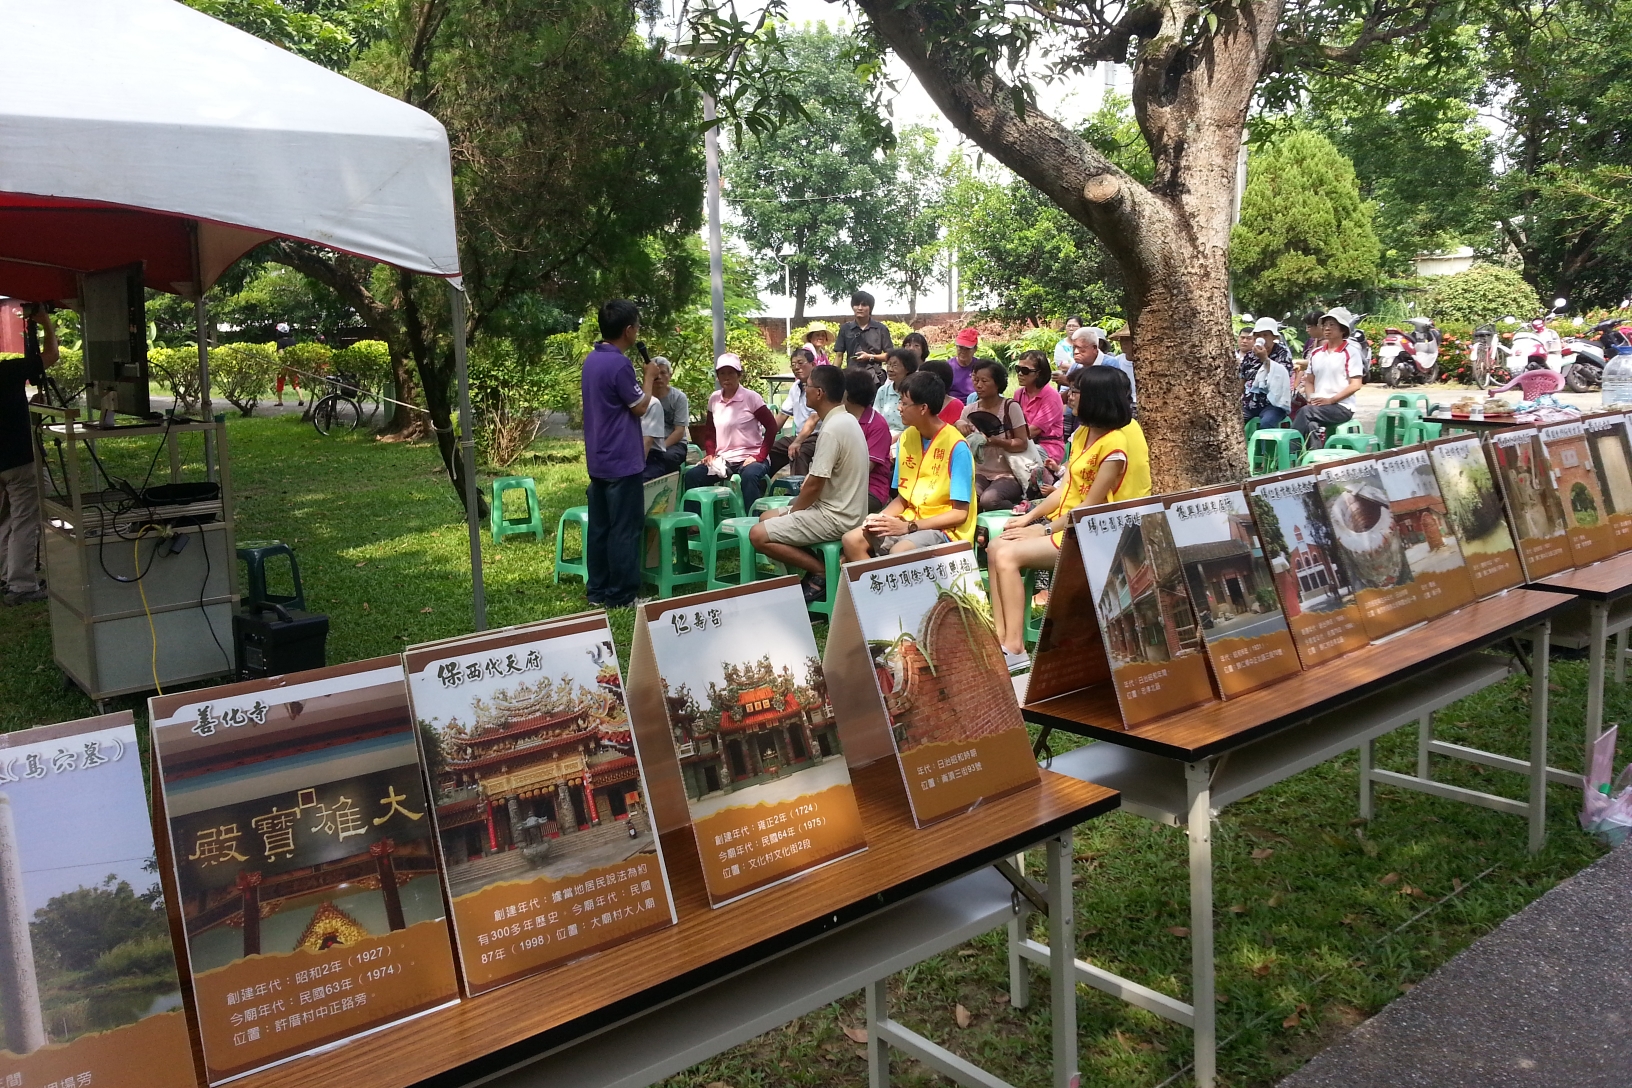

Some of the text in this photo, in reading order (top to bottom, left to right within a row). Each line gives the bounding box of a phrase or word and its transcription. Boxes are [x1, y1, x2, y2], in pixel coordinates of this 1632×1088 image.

[898, 454, 917, 490] 志工
[437, 650, 540, 686] 保西代天府
[192, 701, 269, 735] 善化寺
[0, 1071, 22, 1088] 間
